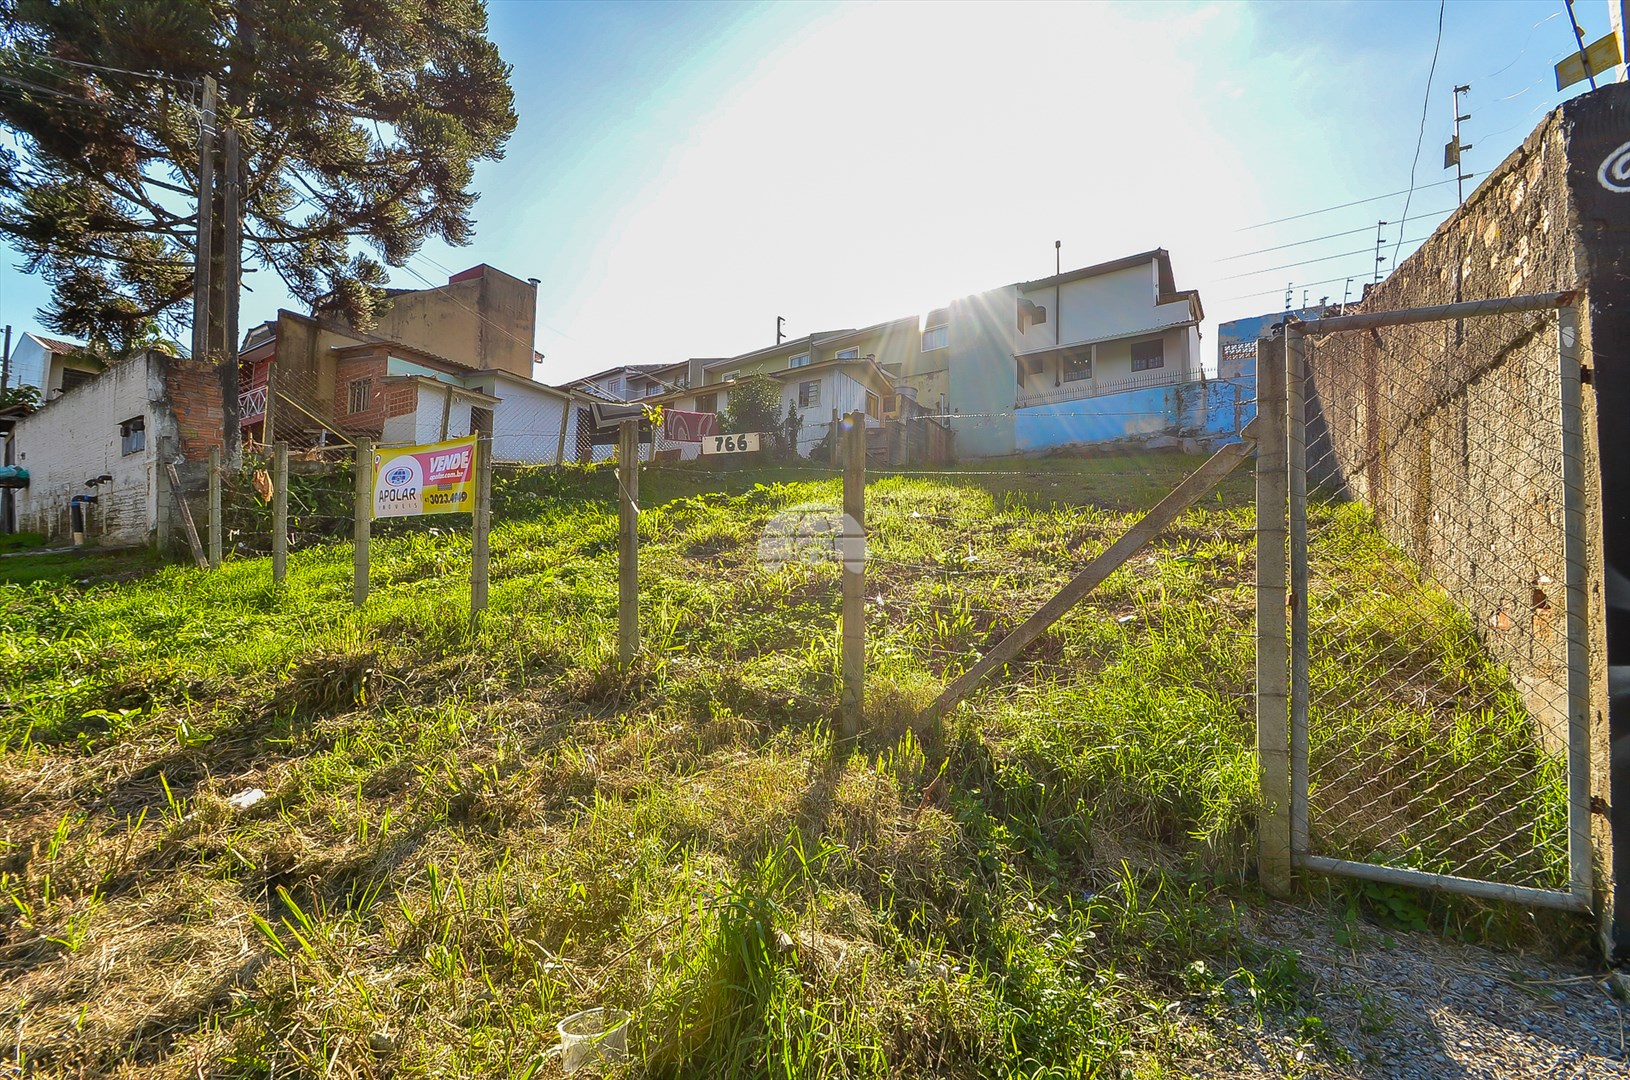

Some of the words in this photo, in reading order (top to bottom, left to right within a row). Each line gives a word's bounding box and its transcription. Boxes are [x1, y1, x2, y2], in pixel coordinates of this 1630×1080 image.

[714, 433, 748, 452] 766
[430, 450, 469, 473] VENDE
[378, 488, 416, 503] APOLAR
